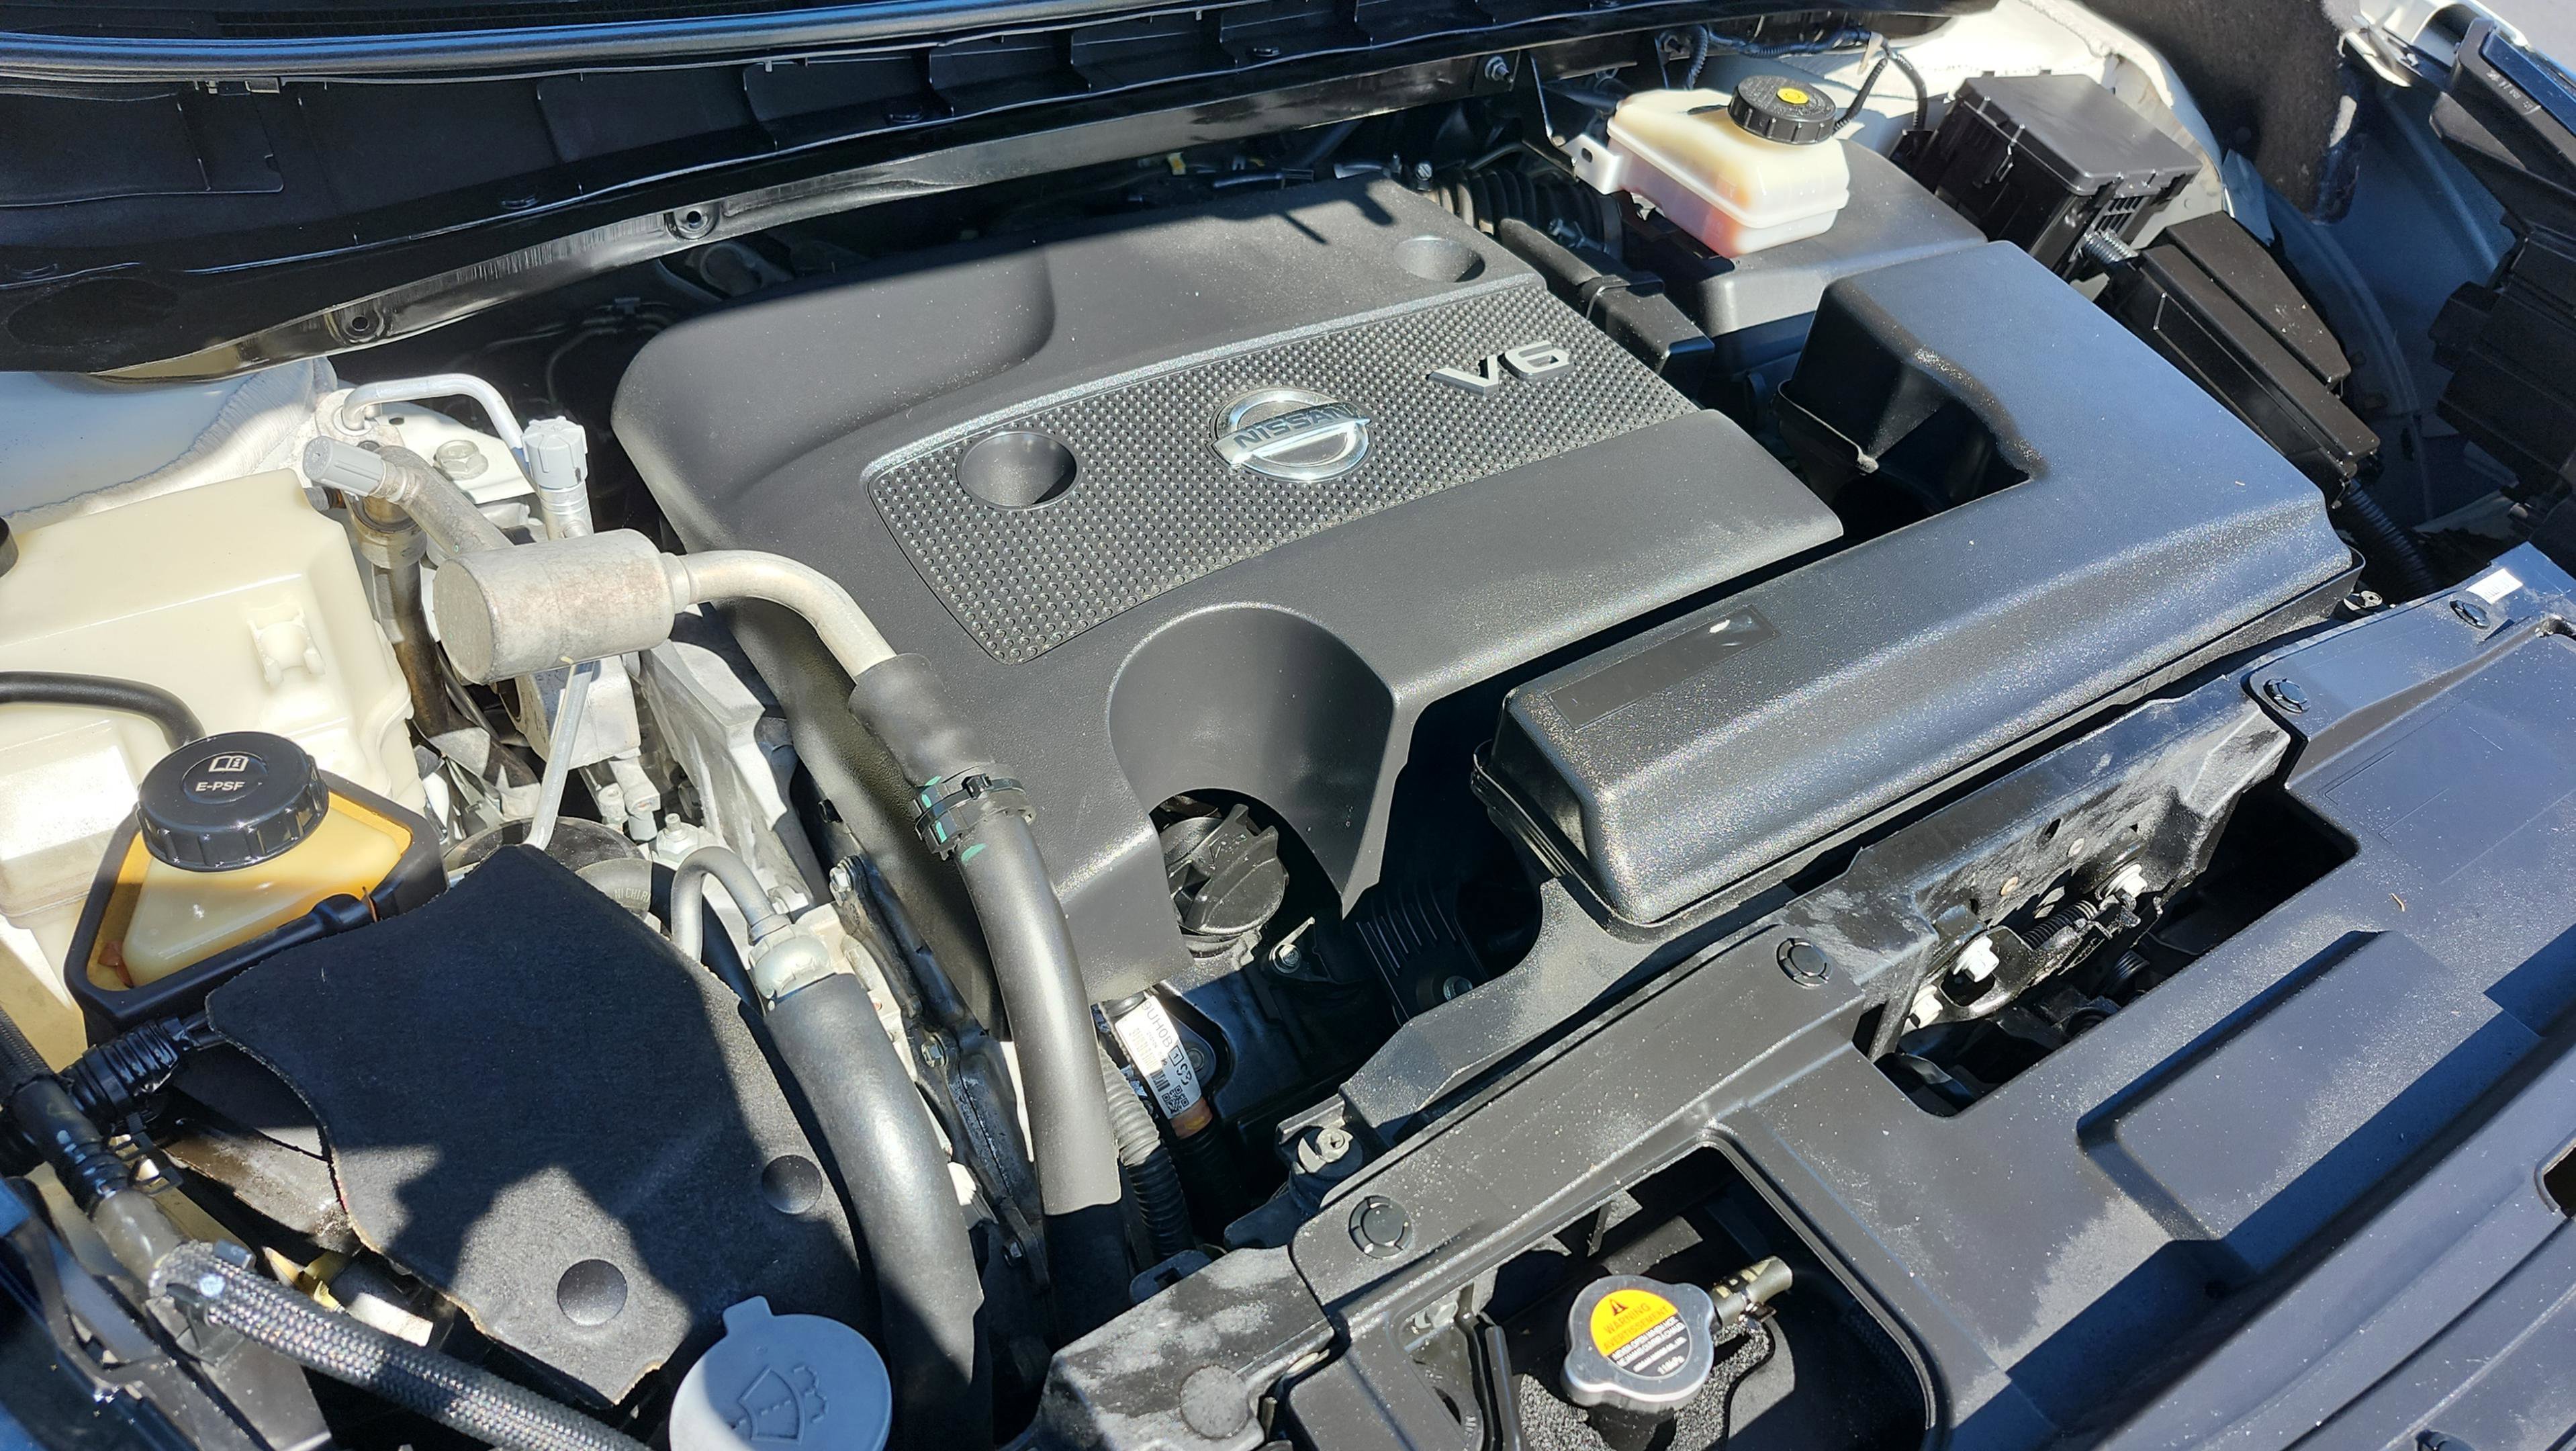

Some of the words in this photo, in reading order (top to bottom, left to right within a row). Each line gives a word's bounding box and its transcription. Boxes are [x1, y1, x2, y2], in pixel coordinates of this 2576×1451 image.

[1428, 339, 1571, 395] V6
[1233, 404, 1354, 449] NISSAN
[195, 781, 245, 791] E-PSF
[1602, 1301, 1651, 1334] WARNING
[1602, 1305, 1669, 1350] AVERTISSEMENT
